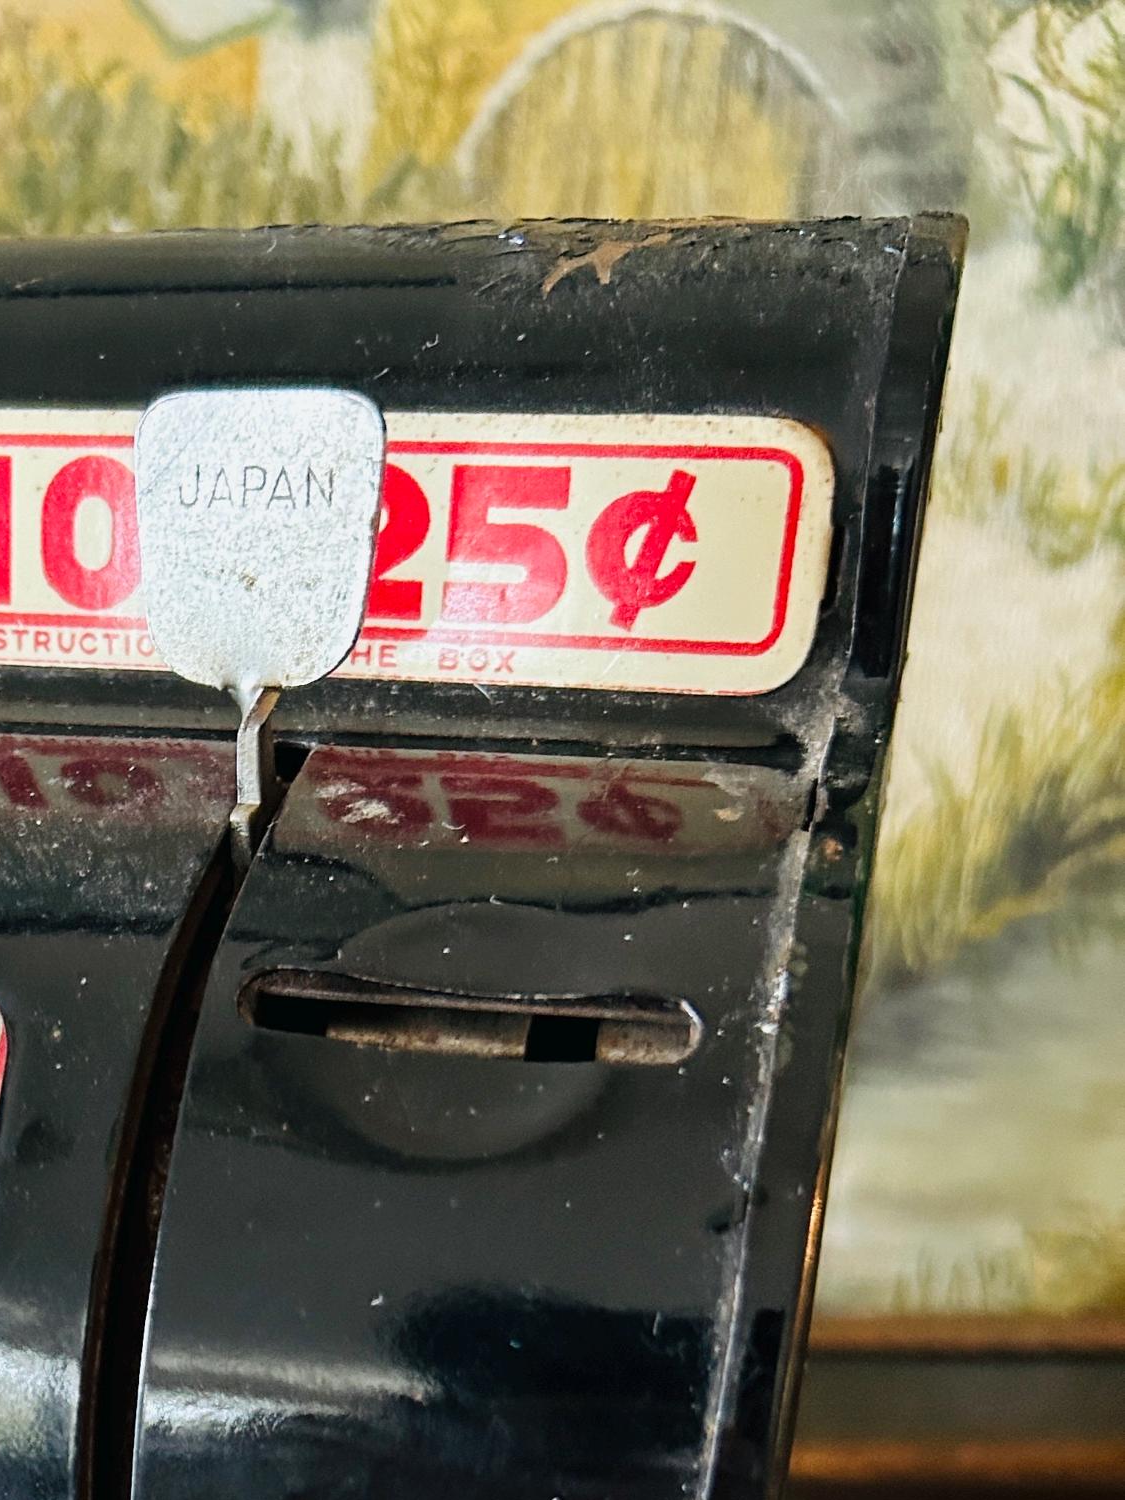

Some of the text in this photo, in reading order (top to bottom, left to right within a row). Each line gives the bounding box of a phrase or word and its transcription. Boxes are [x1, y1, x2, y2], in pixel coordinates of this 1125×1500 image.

[178, 463, 334, 510] JAPAN
[350, 643, 397, 669] HE
[437, 647, 516, 673] BOX
